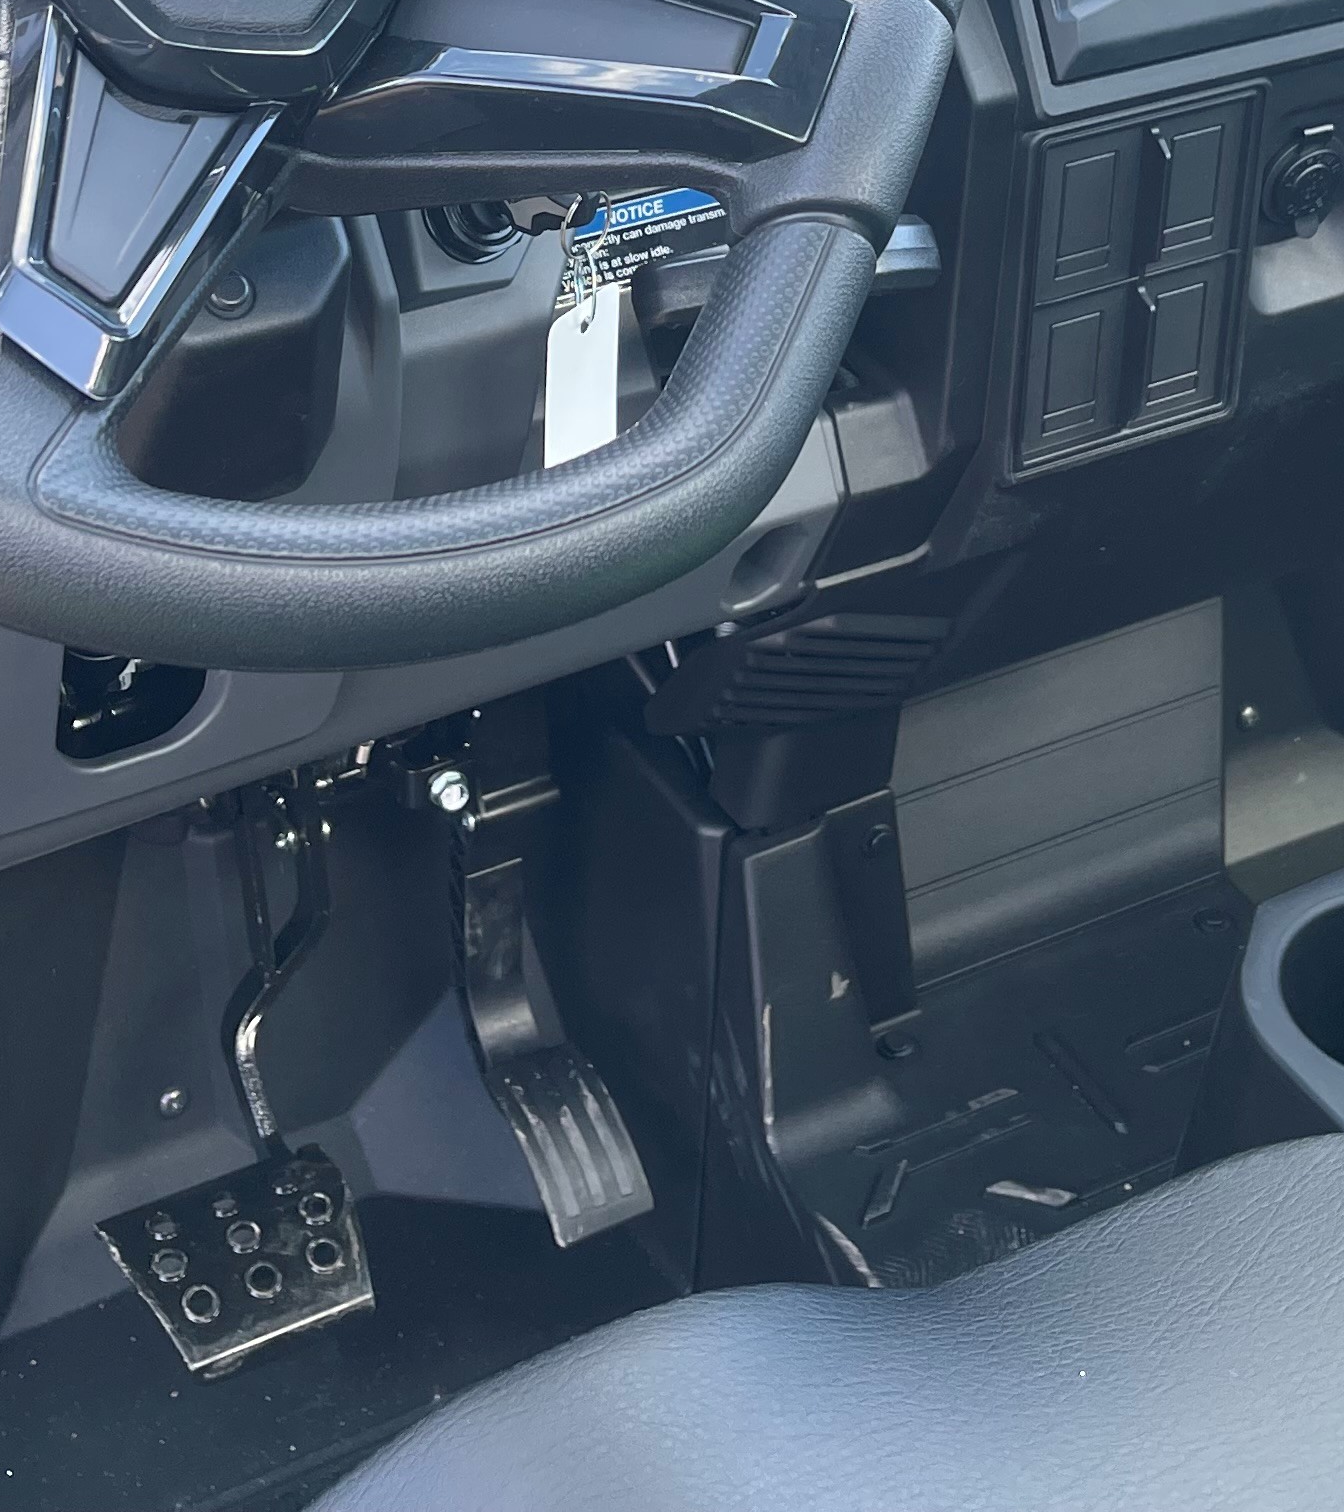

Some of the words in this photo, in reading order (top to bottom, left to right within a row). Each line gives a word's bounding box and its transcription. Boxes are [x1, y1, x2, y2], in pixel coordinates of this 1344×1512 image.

[622, 228, 644, 241] can
[644, 217, 687, 236] damage
[623, 250, 649, 265] slow
